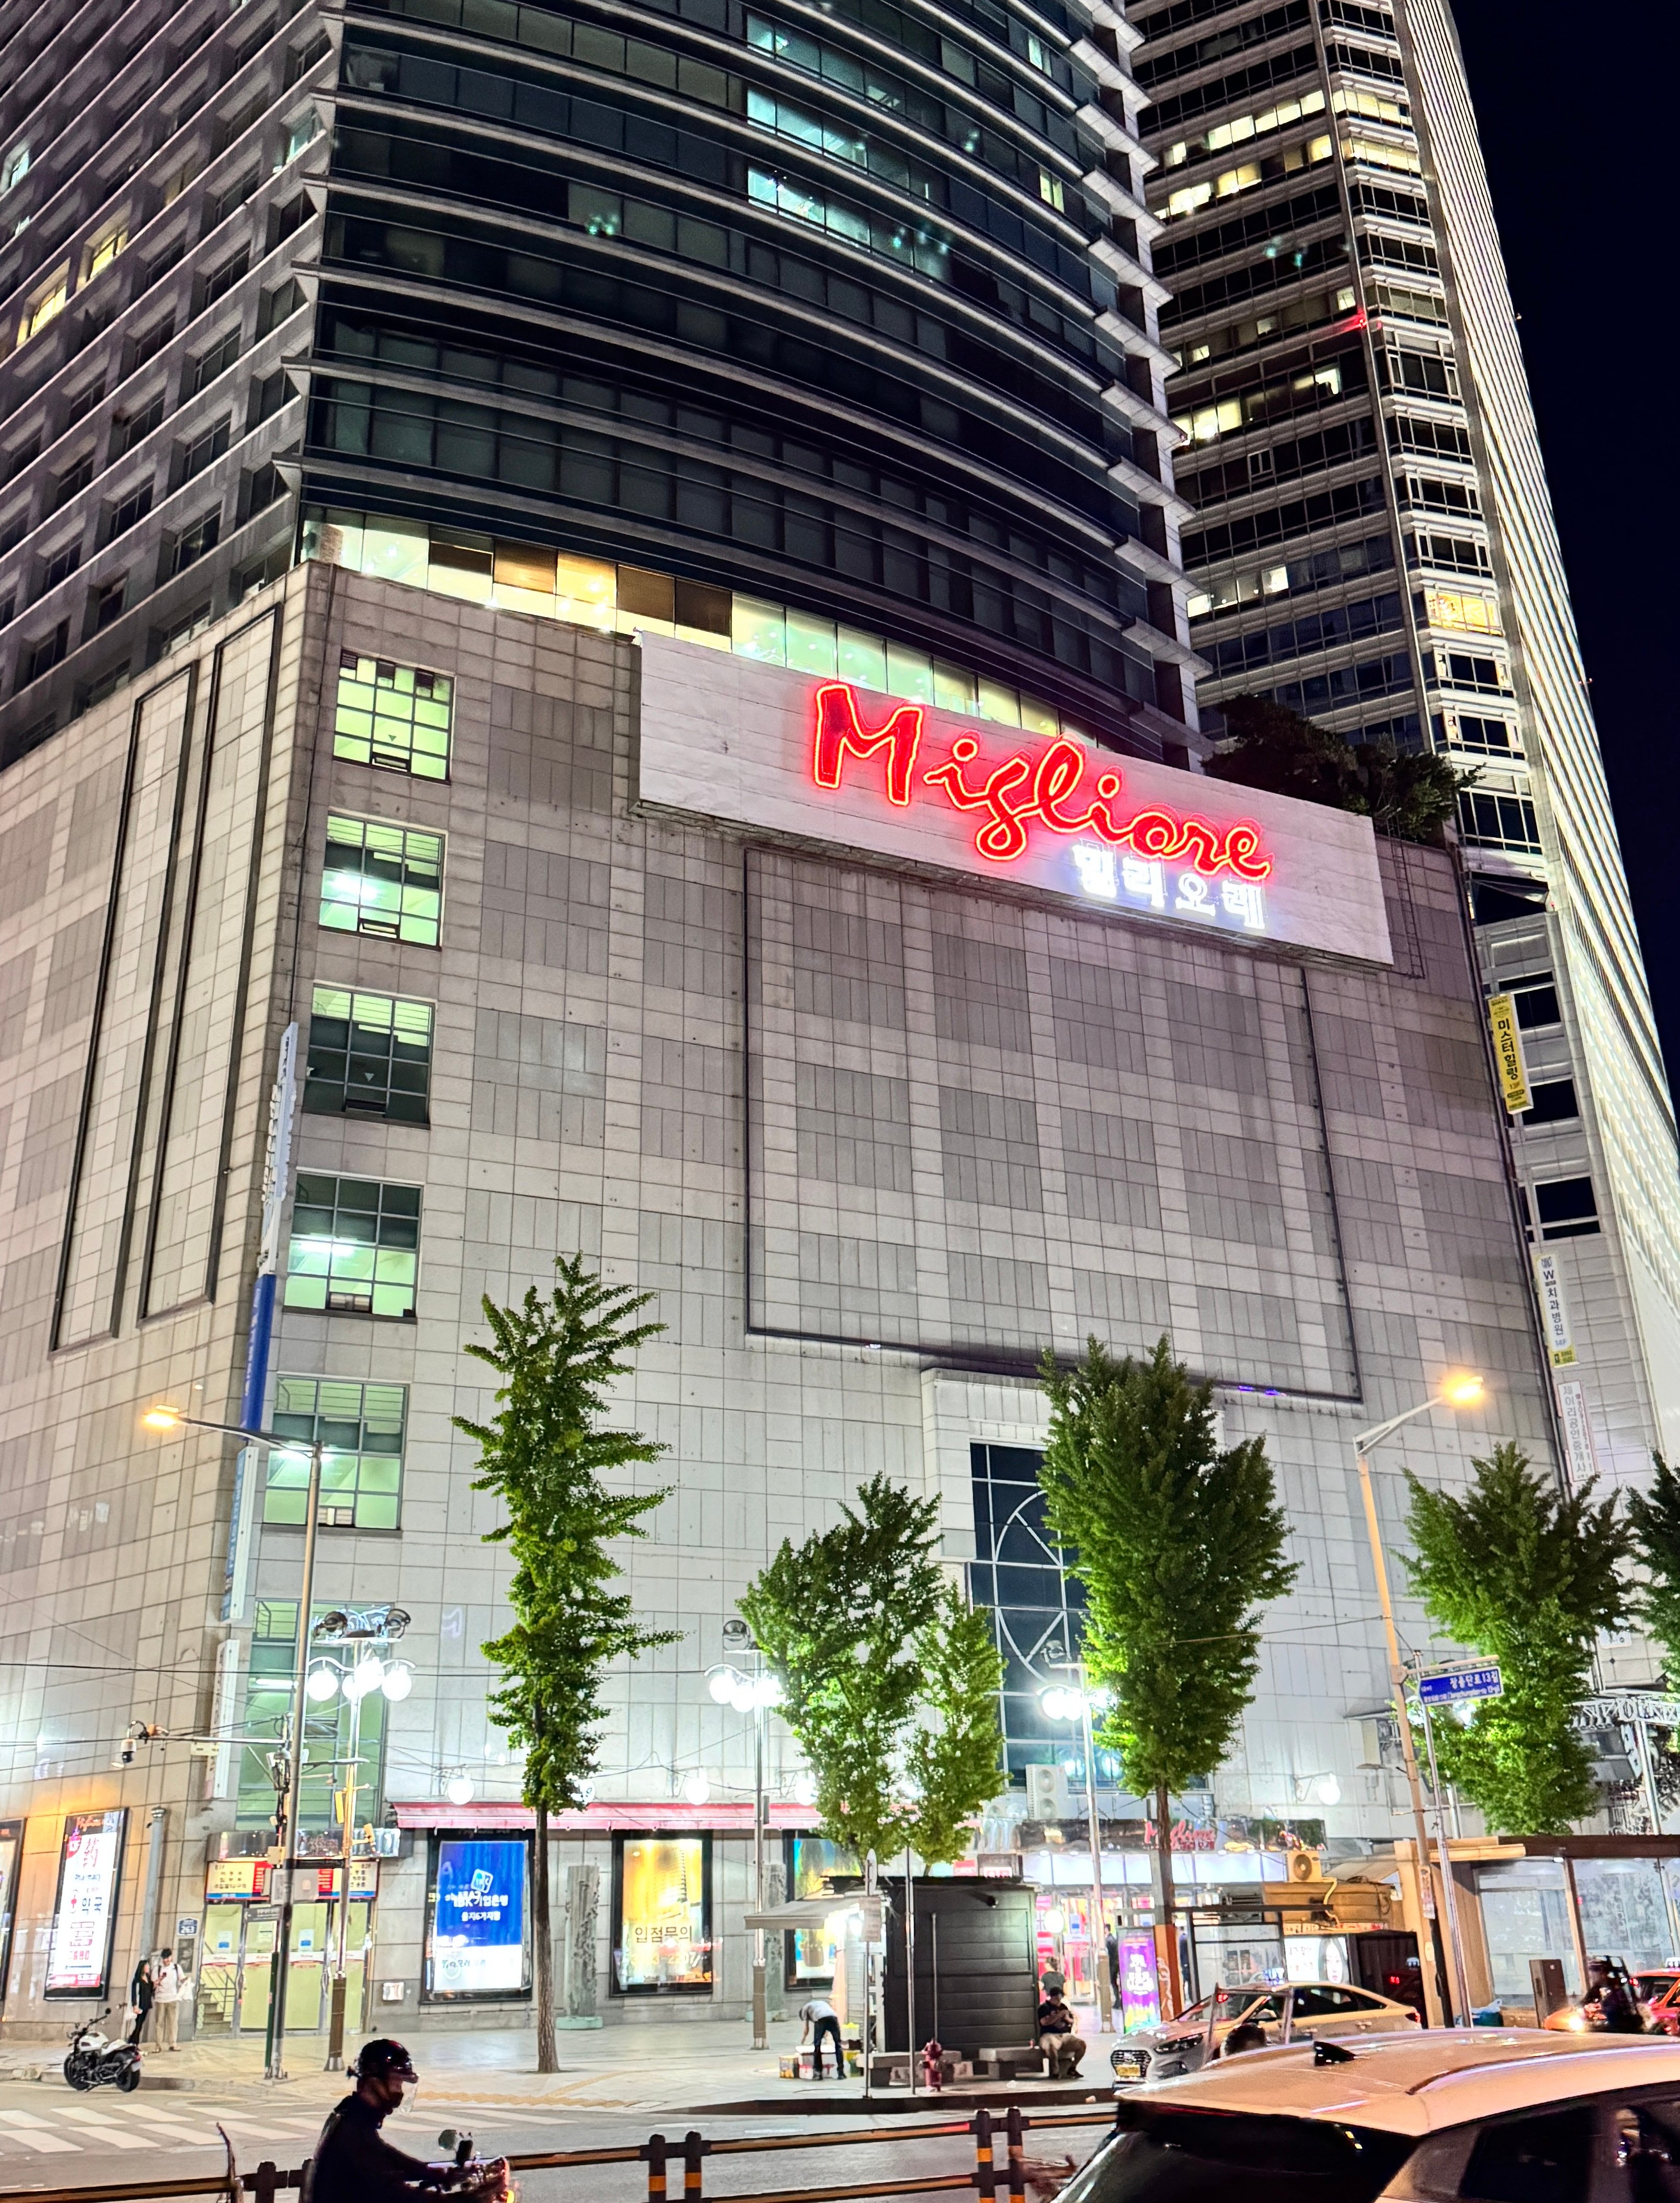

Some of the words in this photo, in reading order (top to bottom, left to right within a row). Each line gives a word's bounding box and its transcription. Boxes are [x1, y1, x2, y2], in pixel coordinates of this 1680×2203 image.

[812, 680, 1275, 881] Migliore
[1072, 838, 1266, 930] 밀리오레
[1498, 1018, 1518, 1081] 미스터힐링
[1548, 1287, 1564, 1335] 치과병원
[635, 1925, 692, 1943] 입점문의
